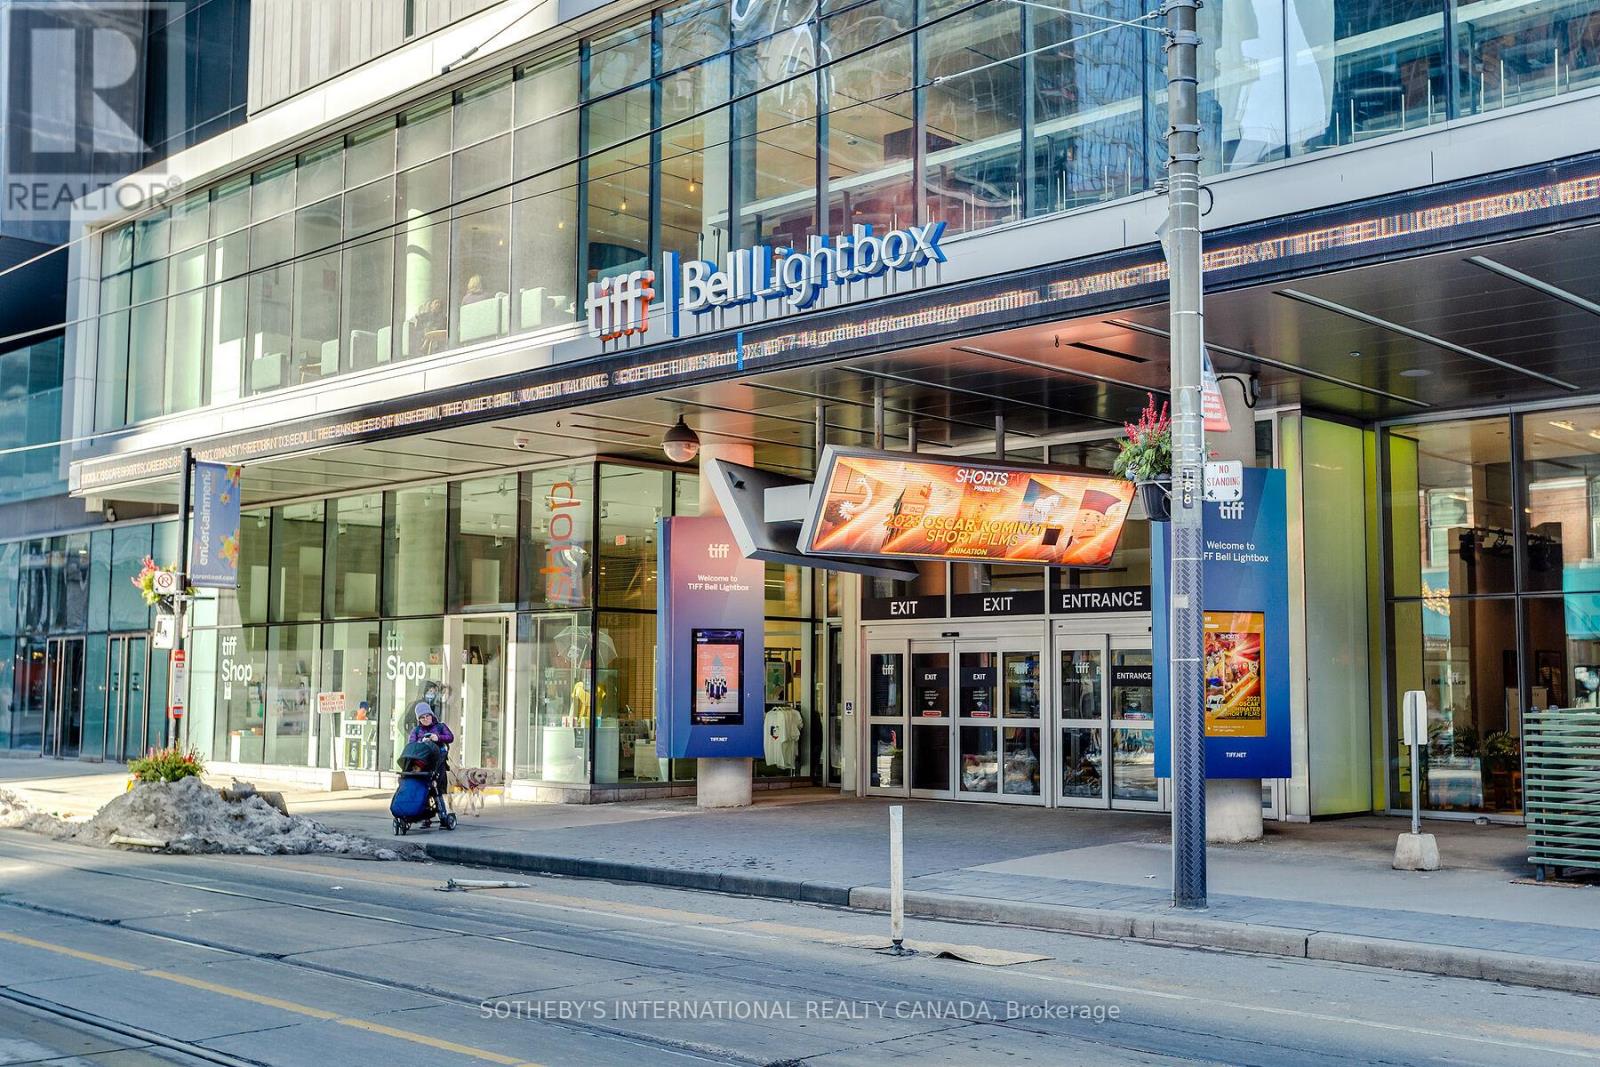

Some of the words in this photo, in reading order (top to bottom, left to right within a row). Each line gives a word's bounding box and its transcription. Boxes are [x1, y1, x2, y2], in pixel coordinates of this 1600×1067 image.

[585, 270, 655, 340] tiff
[683, 248, 753, 313] Bell
[753, 222, 948, 310] Lightbox
[1219, 465, 1229, 474] NO
[1206, 477, 1241, 486] STANDING
[1219, 501, 1244, 519] tiff
[200, 470, 212, 566] entertainment
[923, 516, 976, 533] OSCAR
[978, 520, 1064, 537] NOMINAT
[540, 481, 581, 600] shop
[926, 529, 975, 545] SHORT
[978, 533, 1018, 546] FILMS
[708, 544, 729, 559] tiff
[947, 548, 988, 556] ANIMATION
[1206, 541, 1244, 550] Welcome
[1246, 542, 1255, 550] to
[1216, 552, 1231, 561] Bell
[1233, 553, 1269, 563] Lightbox
[697, 574, 729, 583] Welcome
[688, 582, 703, 591] TIFF
[705, 583, 718, 591] Bell
[719, 583, 749, 592] Lightbox
[984, 597, 1013, 612] EXIT
[1062, 591, 1143, 609] ENTRANCE
[890, 601, 918, 615] EXIT
[222, 636, 237, 655] tiff
[221, 658, 253, 686] Shop
[386, 655, 426, 686] Shop
[881, 664, 894, 676] tiff
[1075, 662, 1089, 674] tiff
[924, 673, 938, 681] EXIT
[1116, 672, 1152, 680] ENTRANCE
